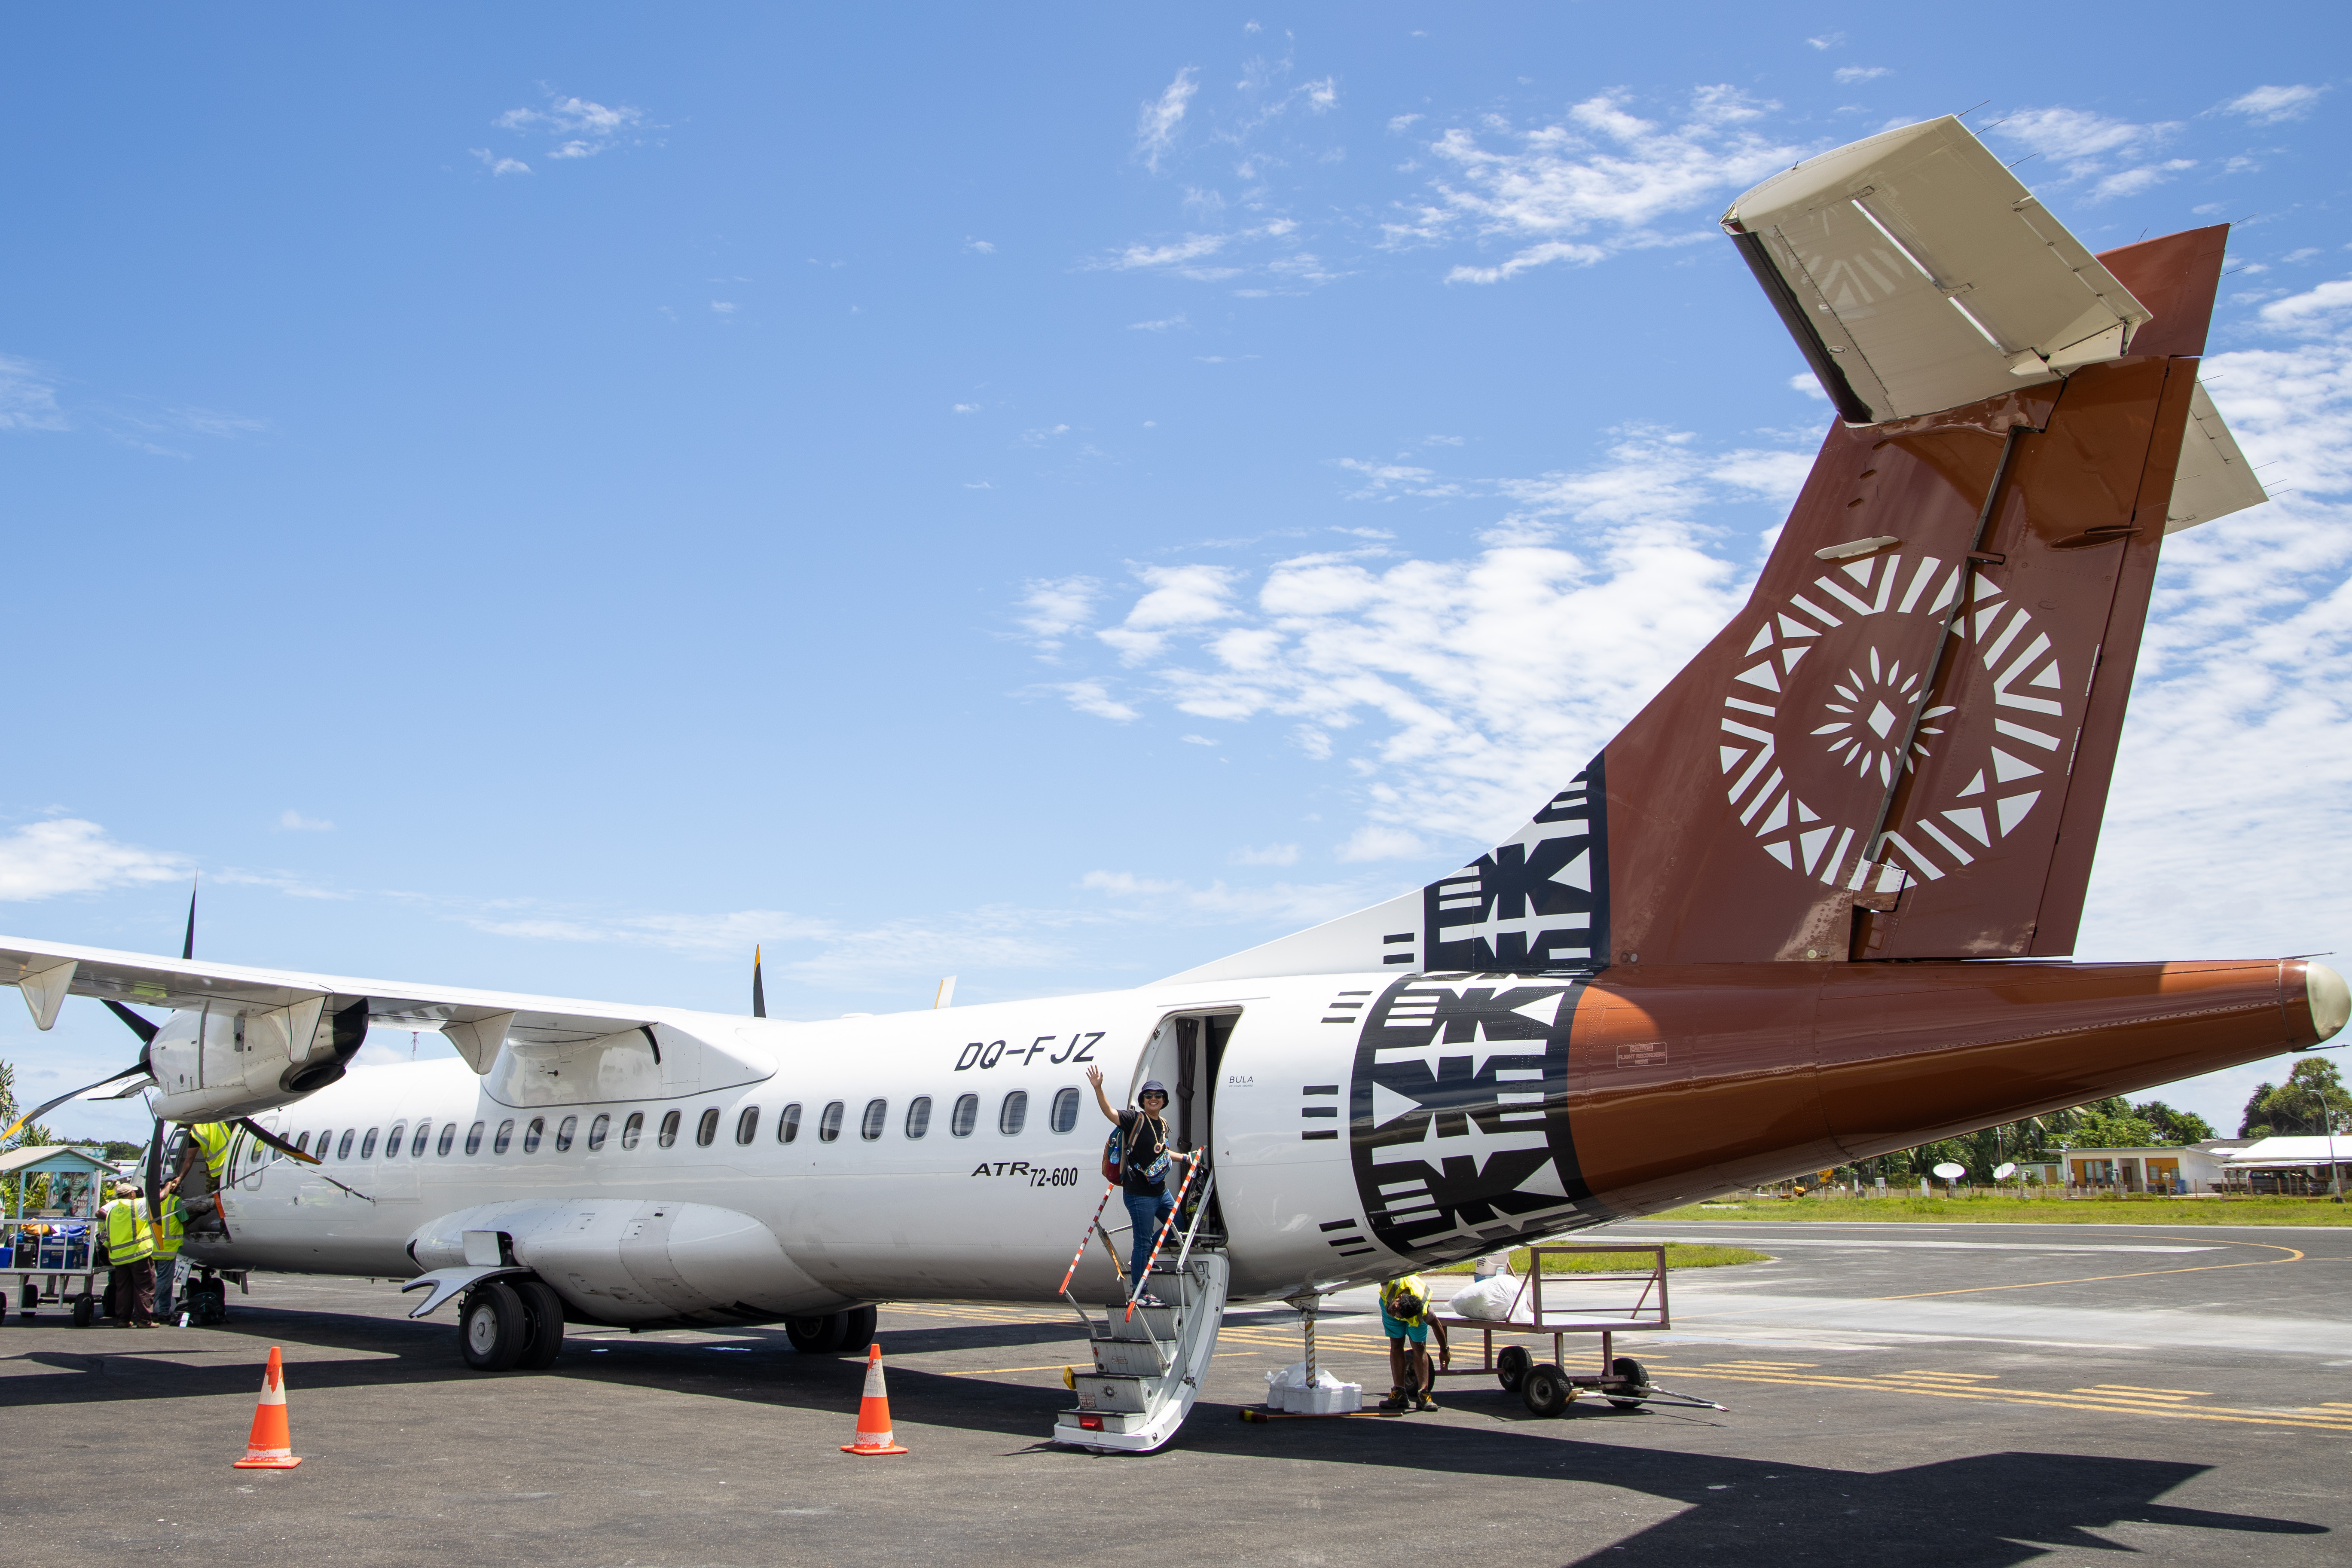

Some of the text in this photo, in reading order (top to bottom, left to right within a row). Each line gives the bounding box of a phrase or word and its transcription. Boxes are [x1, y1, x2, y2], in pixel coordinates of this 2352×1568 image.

[954, 1032, 1106, 1071] DQ-FJZ
[971, 1162, 1030, 1177] ATR
[1030, 1168, 1078, 1187] 72-600
